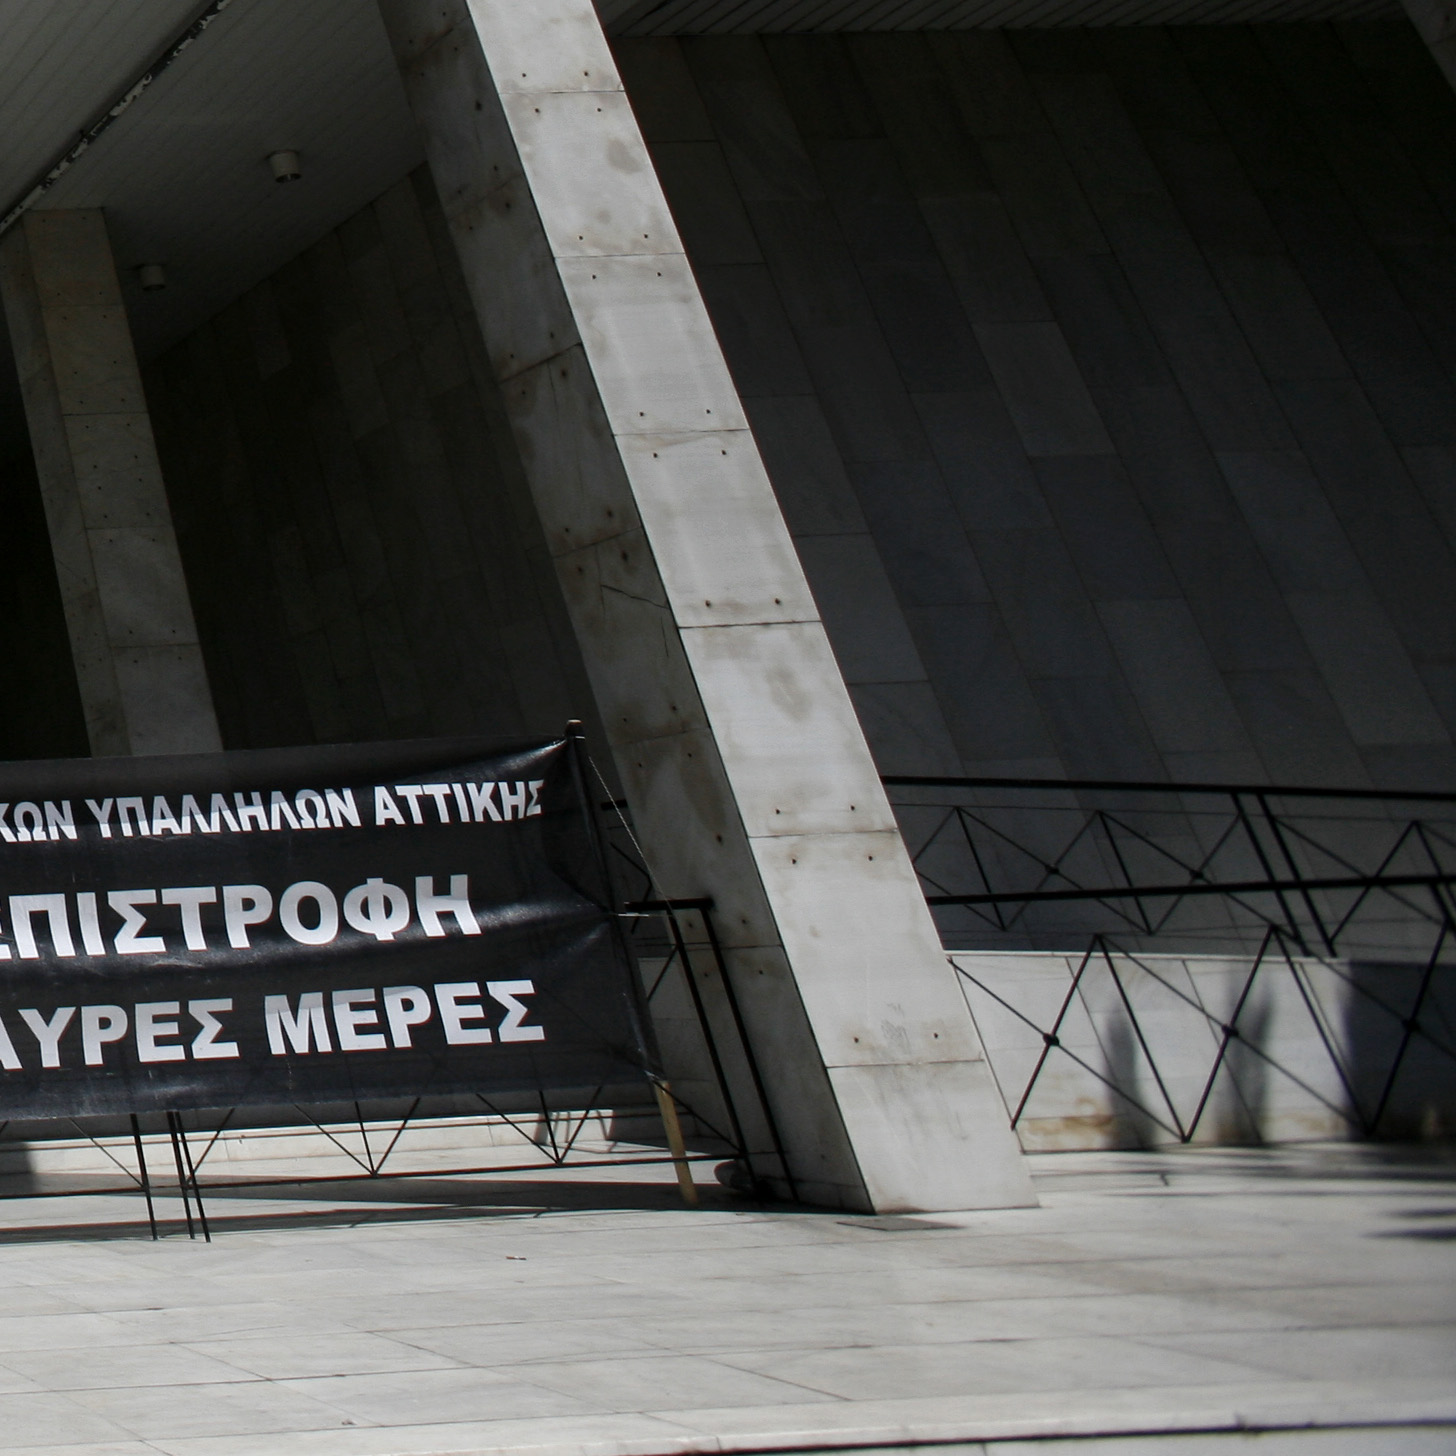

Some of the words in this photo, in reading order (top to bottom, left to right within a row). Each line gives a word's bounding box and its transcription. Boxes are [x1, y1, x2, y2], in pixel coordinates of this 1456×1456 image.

[85, 787, 362, 839] ΥΠΑΛΛΗΛΩΝ
[374, 779, 544, 826] ΑΤΤΙΚΗΣ
[264, 979, 546, 1056] ΜΕΡΕΣ
